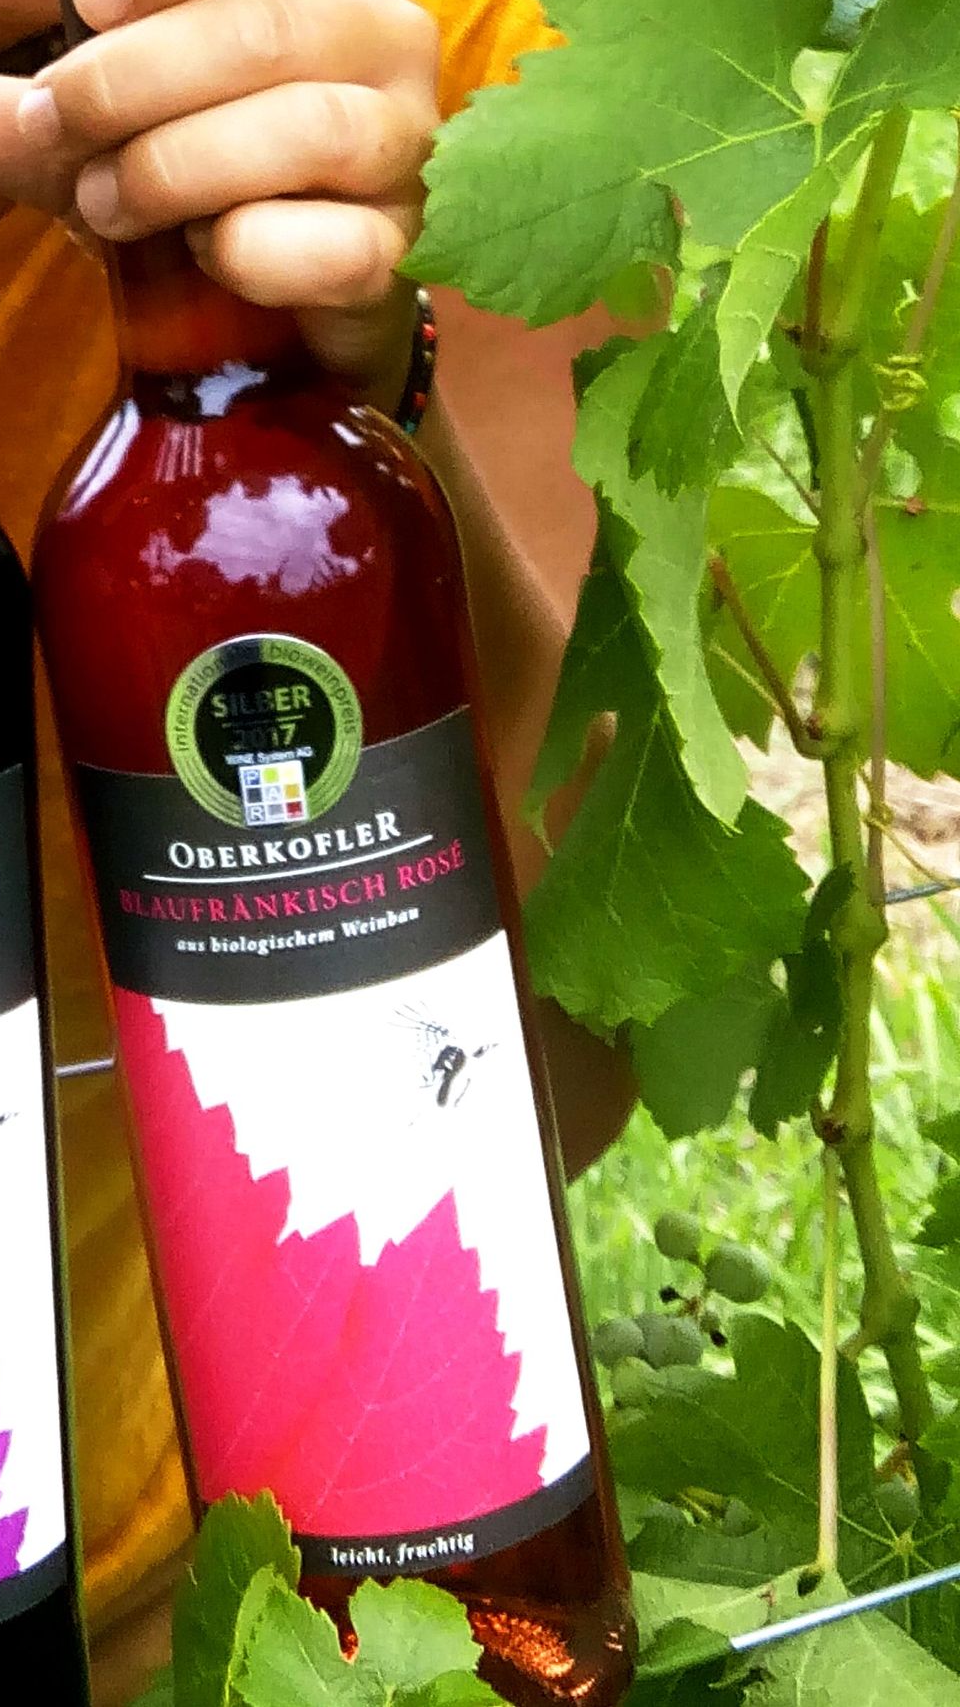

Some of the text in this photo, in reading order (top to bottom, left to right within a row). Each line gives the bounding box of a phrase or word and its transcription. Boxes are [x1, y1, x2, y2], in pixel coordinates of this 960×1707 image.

[211, 685, 313, 719] SILBER
[120, 838, 465, 925] BLAUFRÄNKISCH ROSÉ
[176, 905, 420, 957] aus biologischem Weinbau
[331, 1533, 474, 1567] leicht, fruchtig
